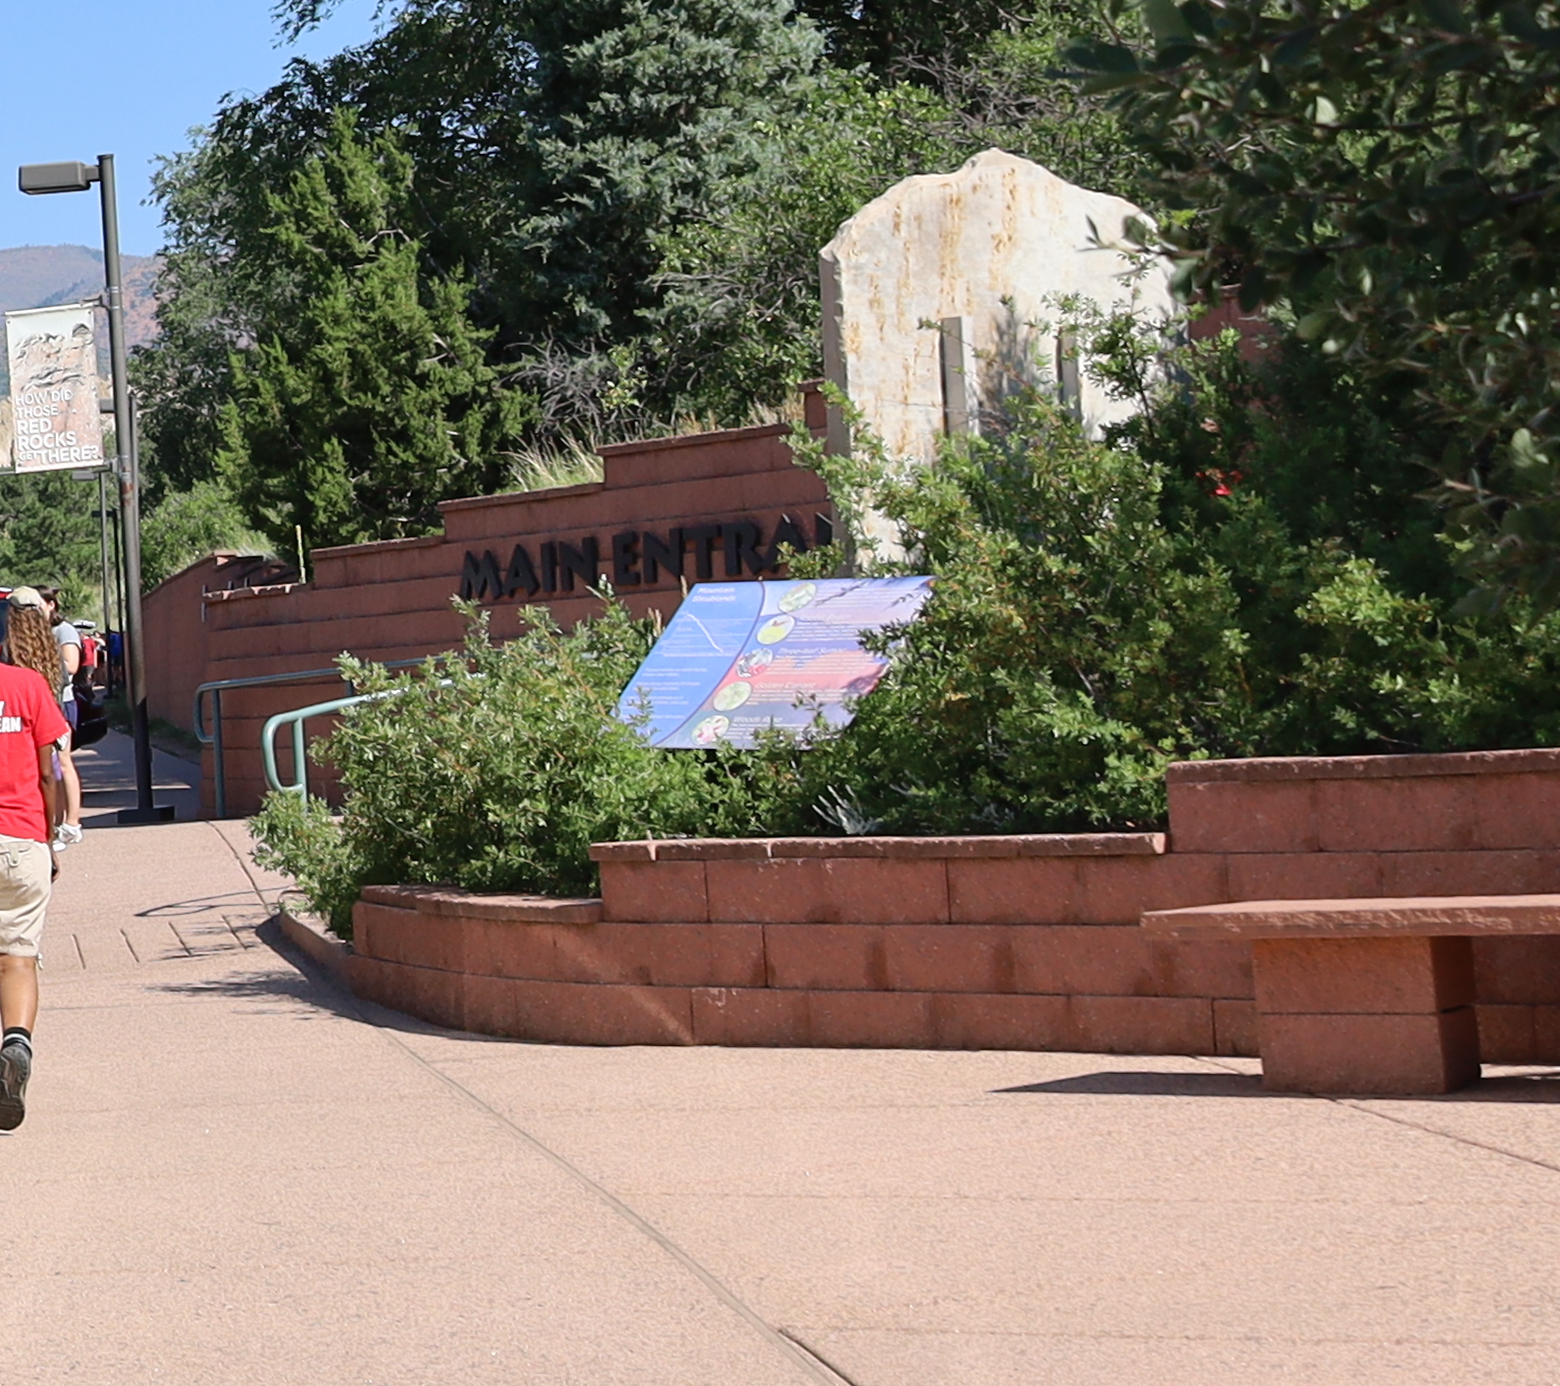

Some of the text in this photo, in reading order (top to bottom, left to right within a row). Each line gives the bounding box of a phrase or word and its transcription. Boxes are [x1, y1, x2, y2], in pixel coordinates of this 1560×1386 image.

[15, 389, 73, 406] HOW DID
[16, 404, 60, 419] THOSE
[16, 418, 52, 435] RED
[17, 431, 77, 451] ROCKS
[19, 445, 99, 464] GET THERE?
[460, 536, 600, 601] MAIN
